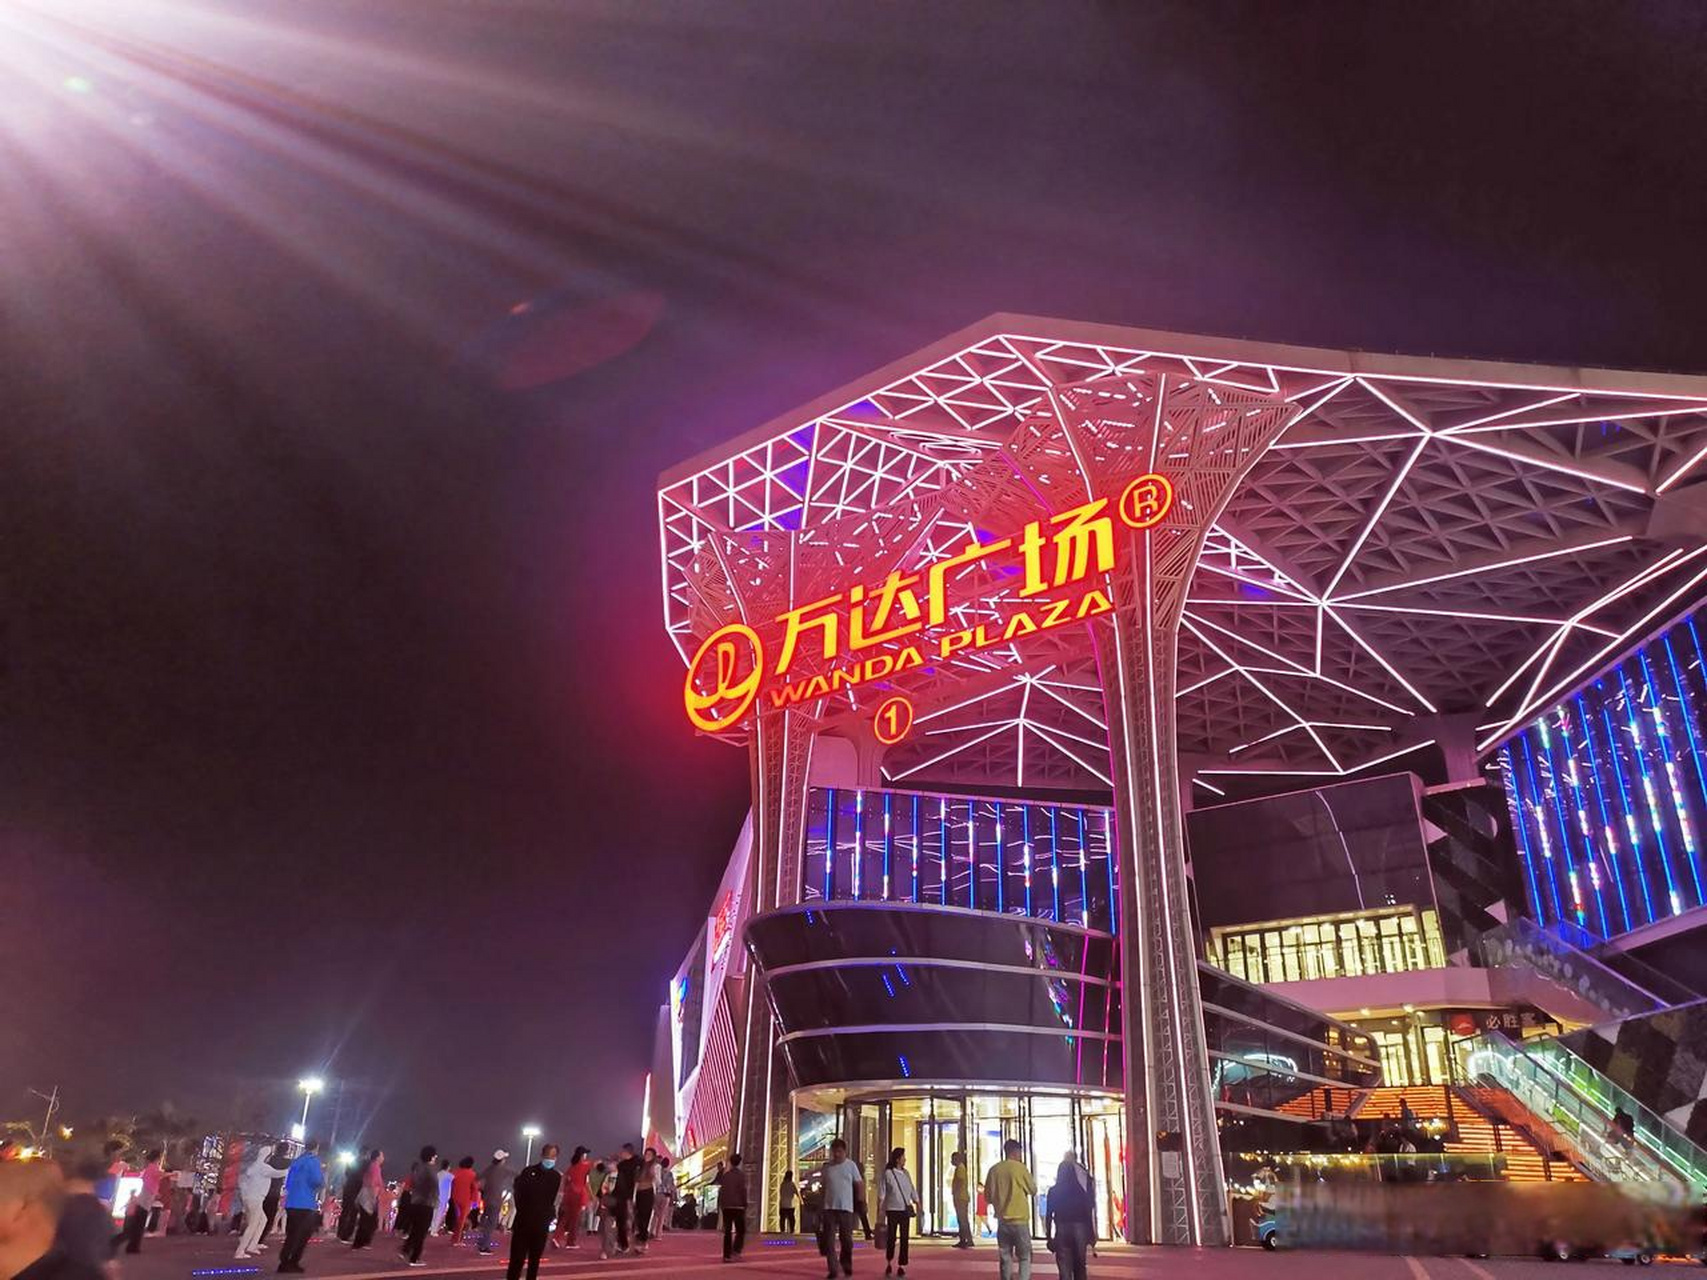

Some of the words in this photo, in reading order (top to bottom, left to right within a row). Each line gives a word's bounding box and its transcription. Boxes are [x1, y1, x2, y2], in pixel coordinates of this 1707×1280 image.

[770, 647, 924, 708] WANDA
[941, 591, 1113, 658] PLAZA
[775, 498, 1114, 675] 万达广场
